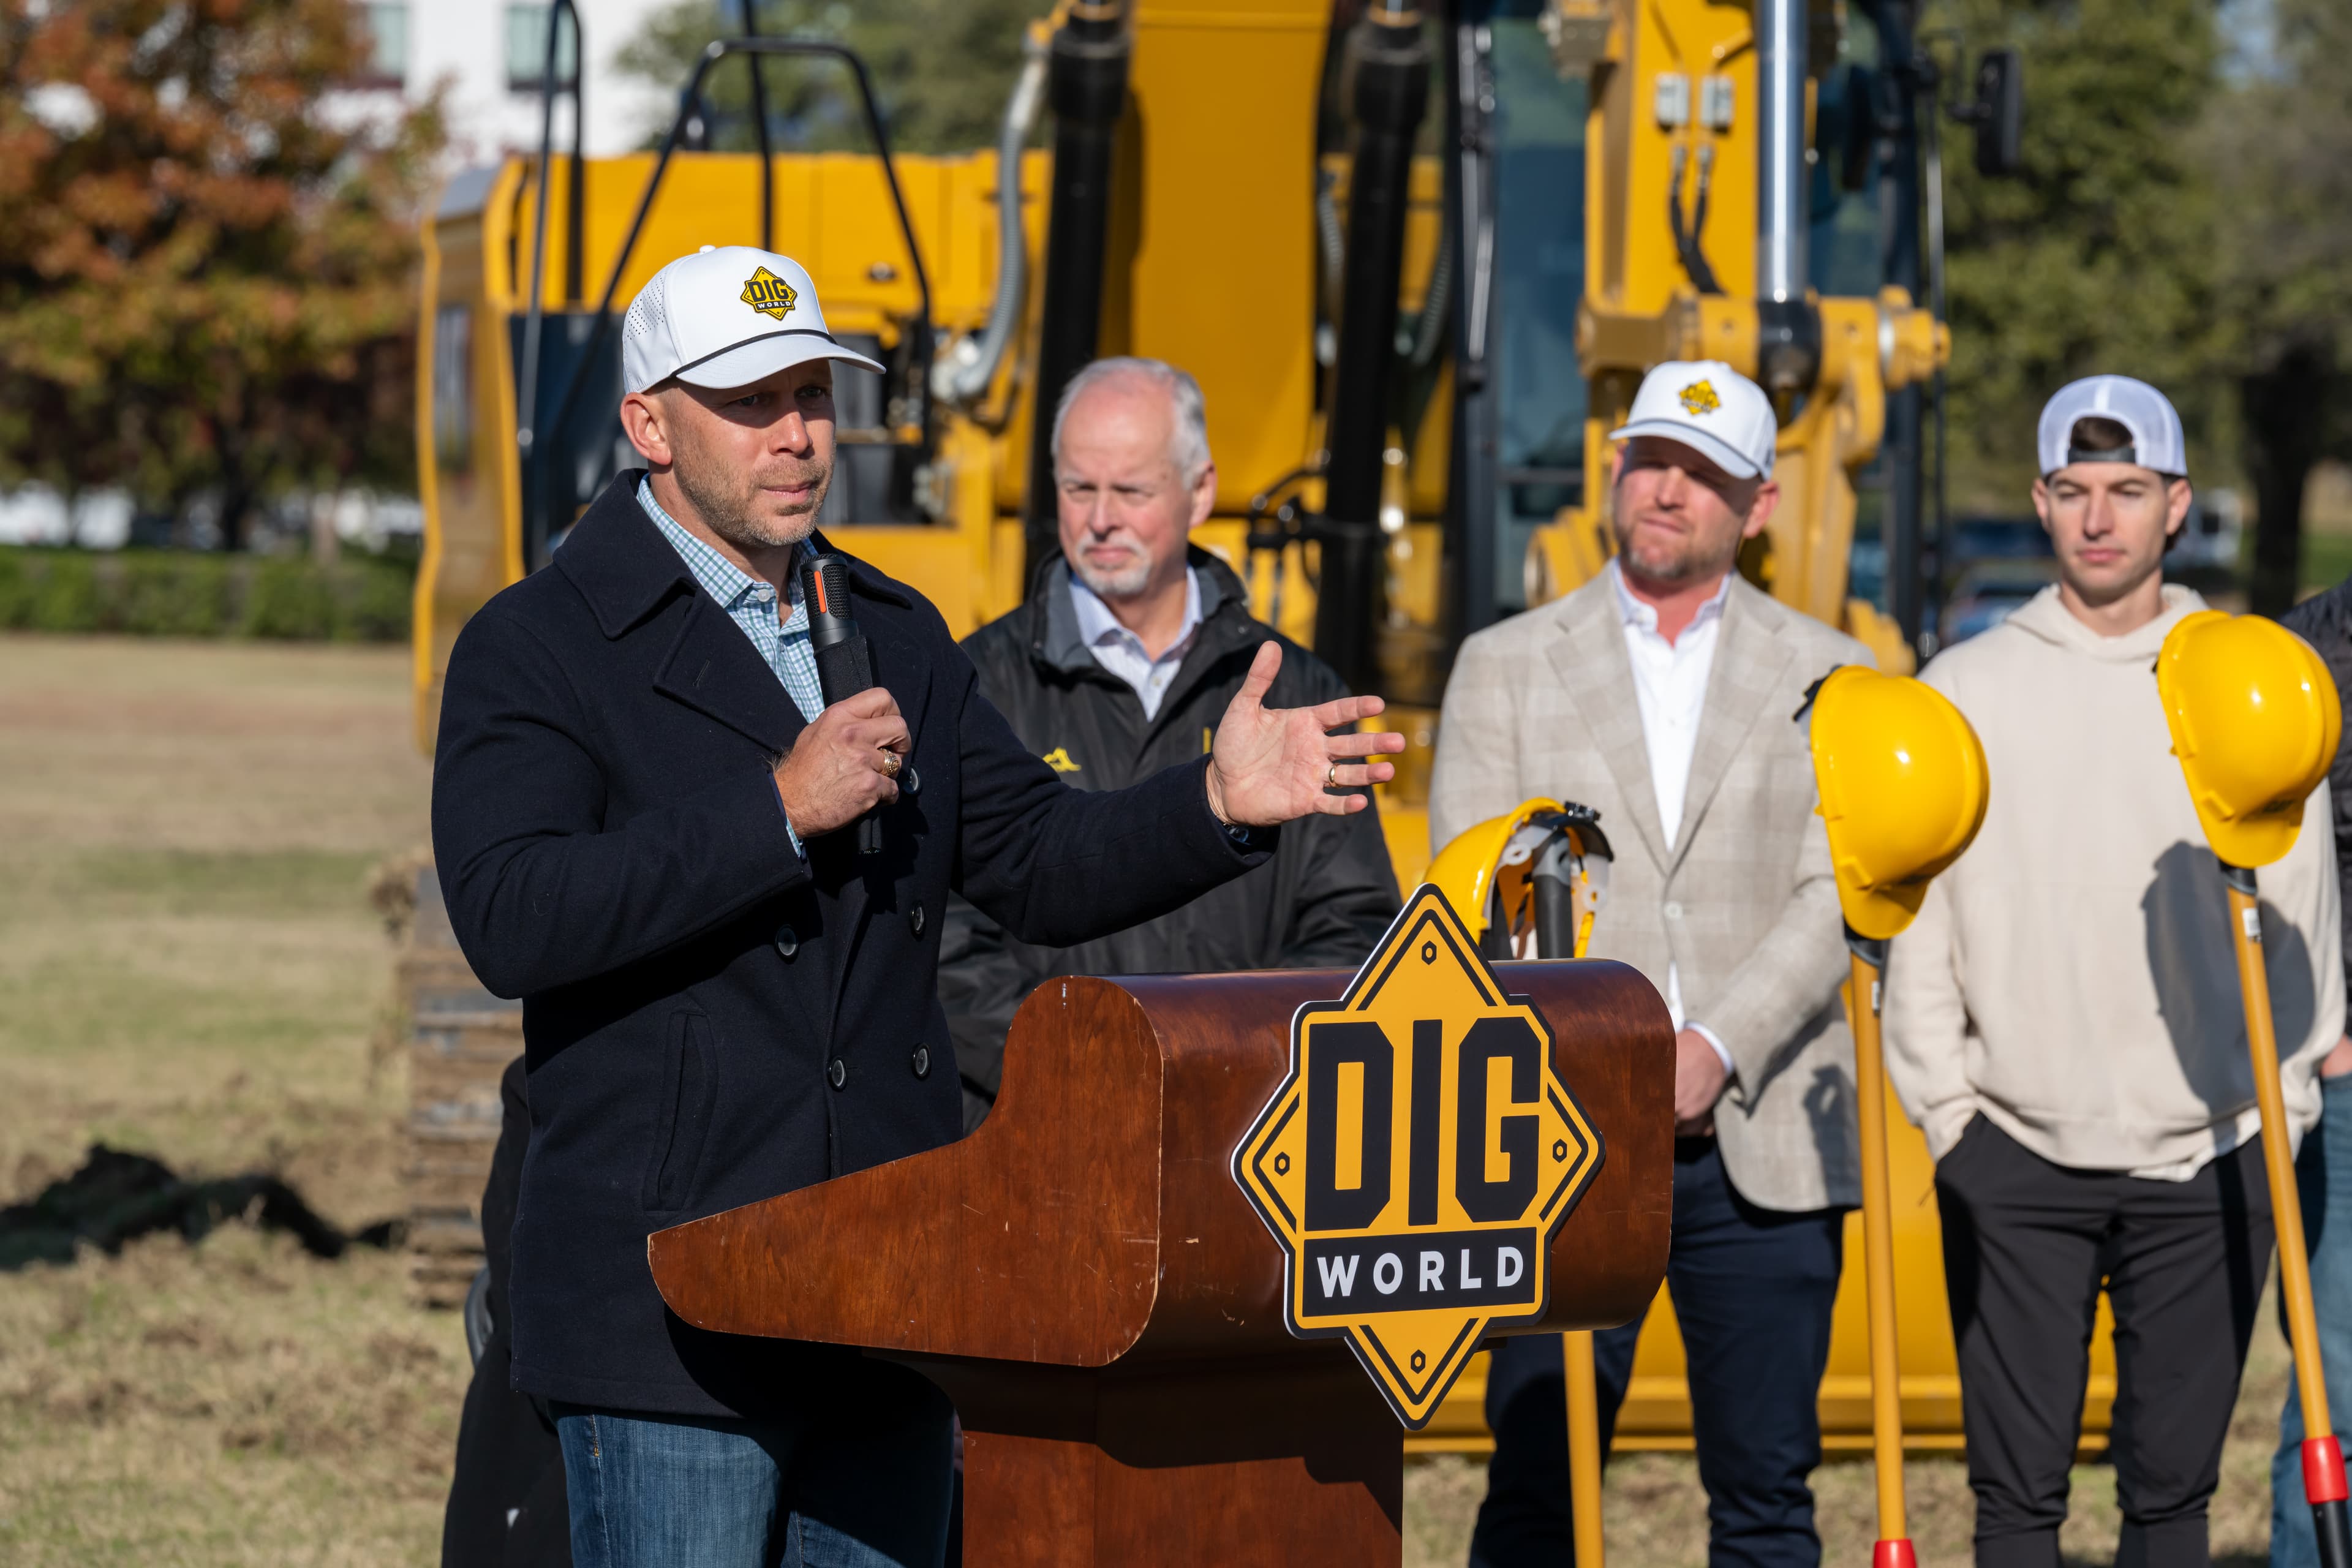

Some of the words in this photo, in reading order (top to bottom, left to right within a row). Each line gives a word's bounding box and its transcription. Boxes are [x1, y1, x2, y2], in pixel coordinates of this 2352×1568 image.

[747, 279, 789, 301] DIG
[1304, 1016, 1542, 1231] DIG
[1317, 1246, 1524, 1298] WORLD
